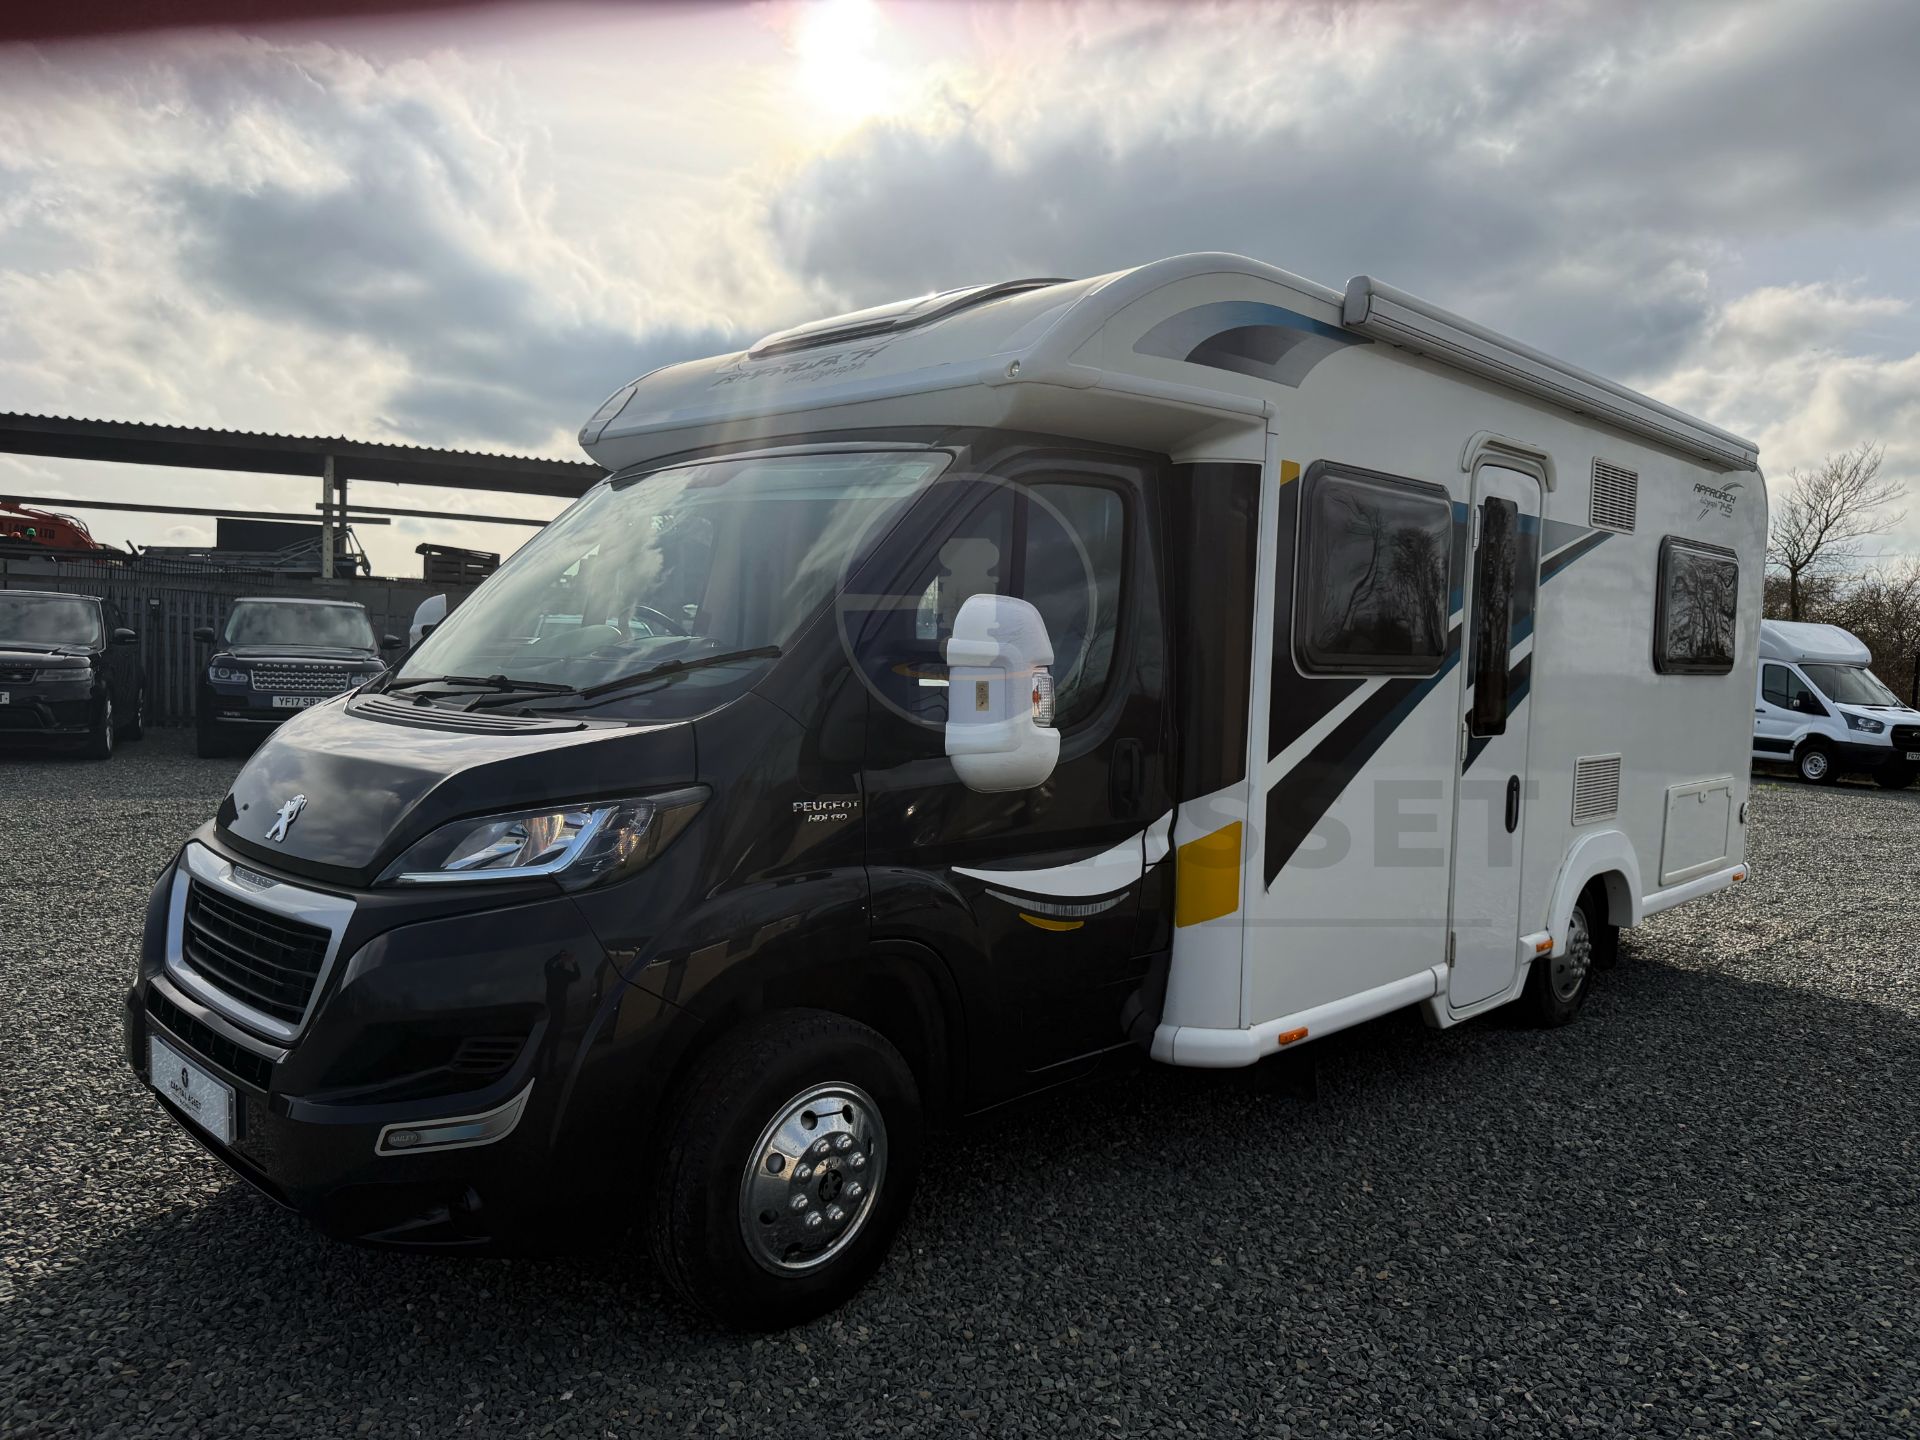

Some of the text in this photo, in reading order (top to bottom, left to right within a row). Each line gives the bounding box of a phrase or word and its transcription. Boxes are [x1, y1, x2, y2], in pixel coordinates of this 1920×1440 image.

[1693, 483, 1736, 504] APPROACH
[1718, 501, 1733, 514] 745
[256, 662, 297, 670] RANGE
[279, 696, 300, 707] YF17
[792, 800, 861, 813] PEUGEOT
